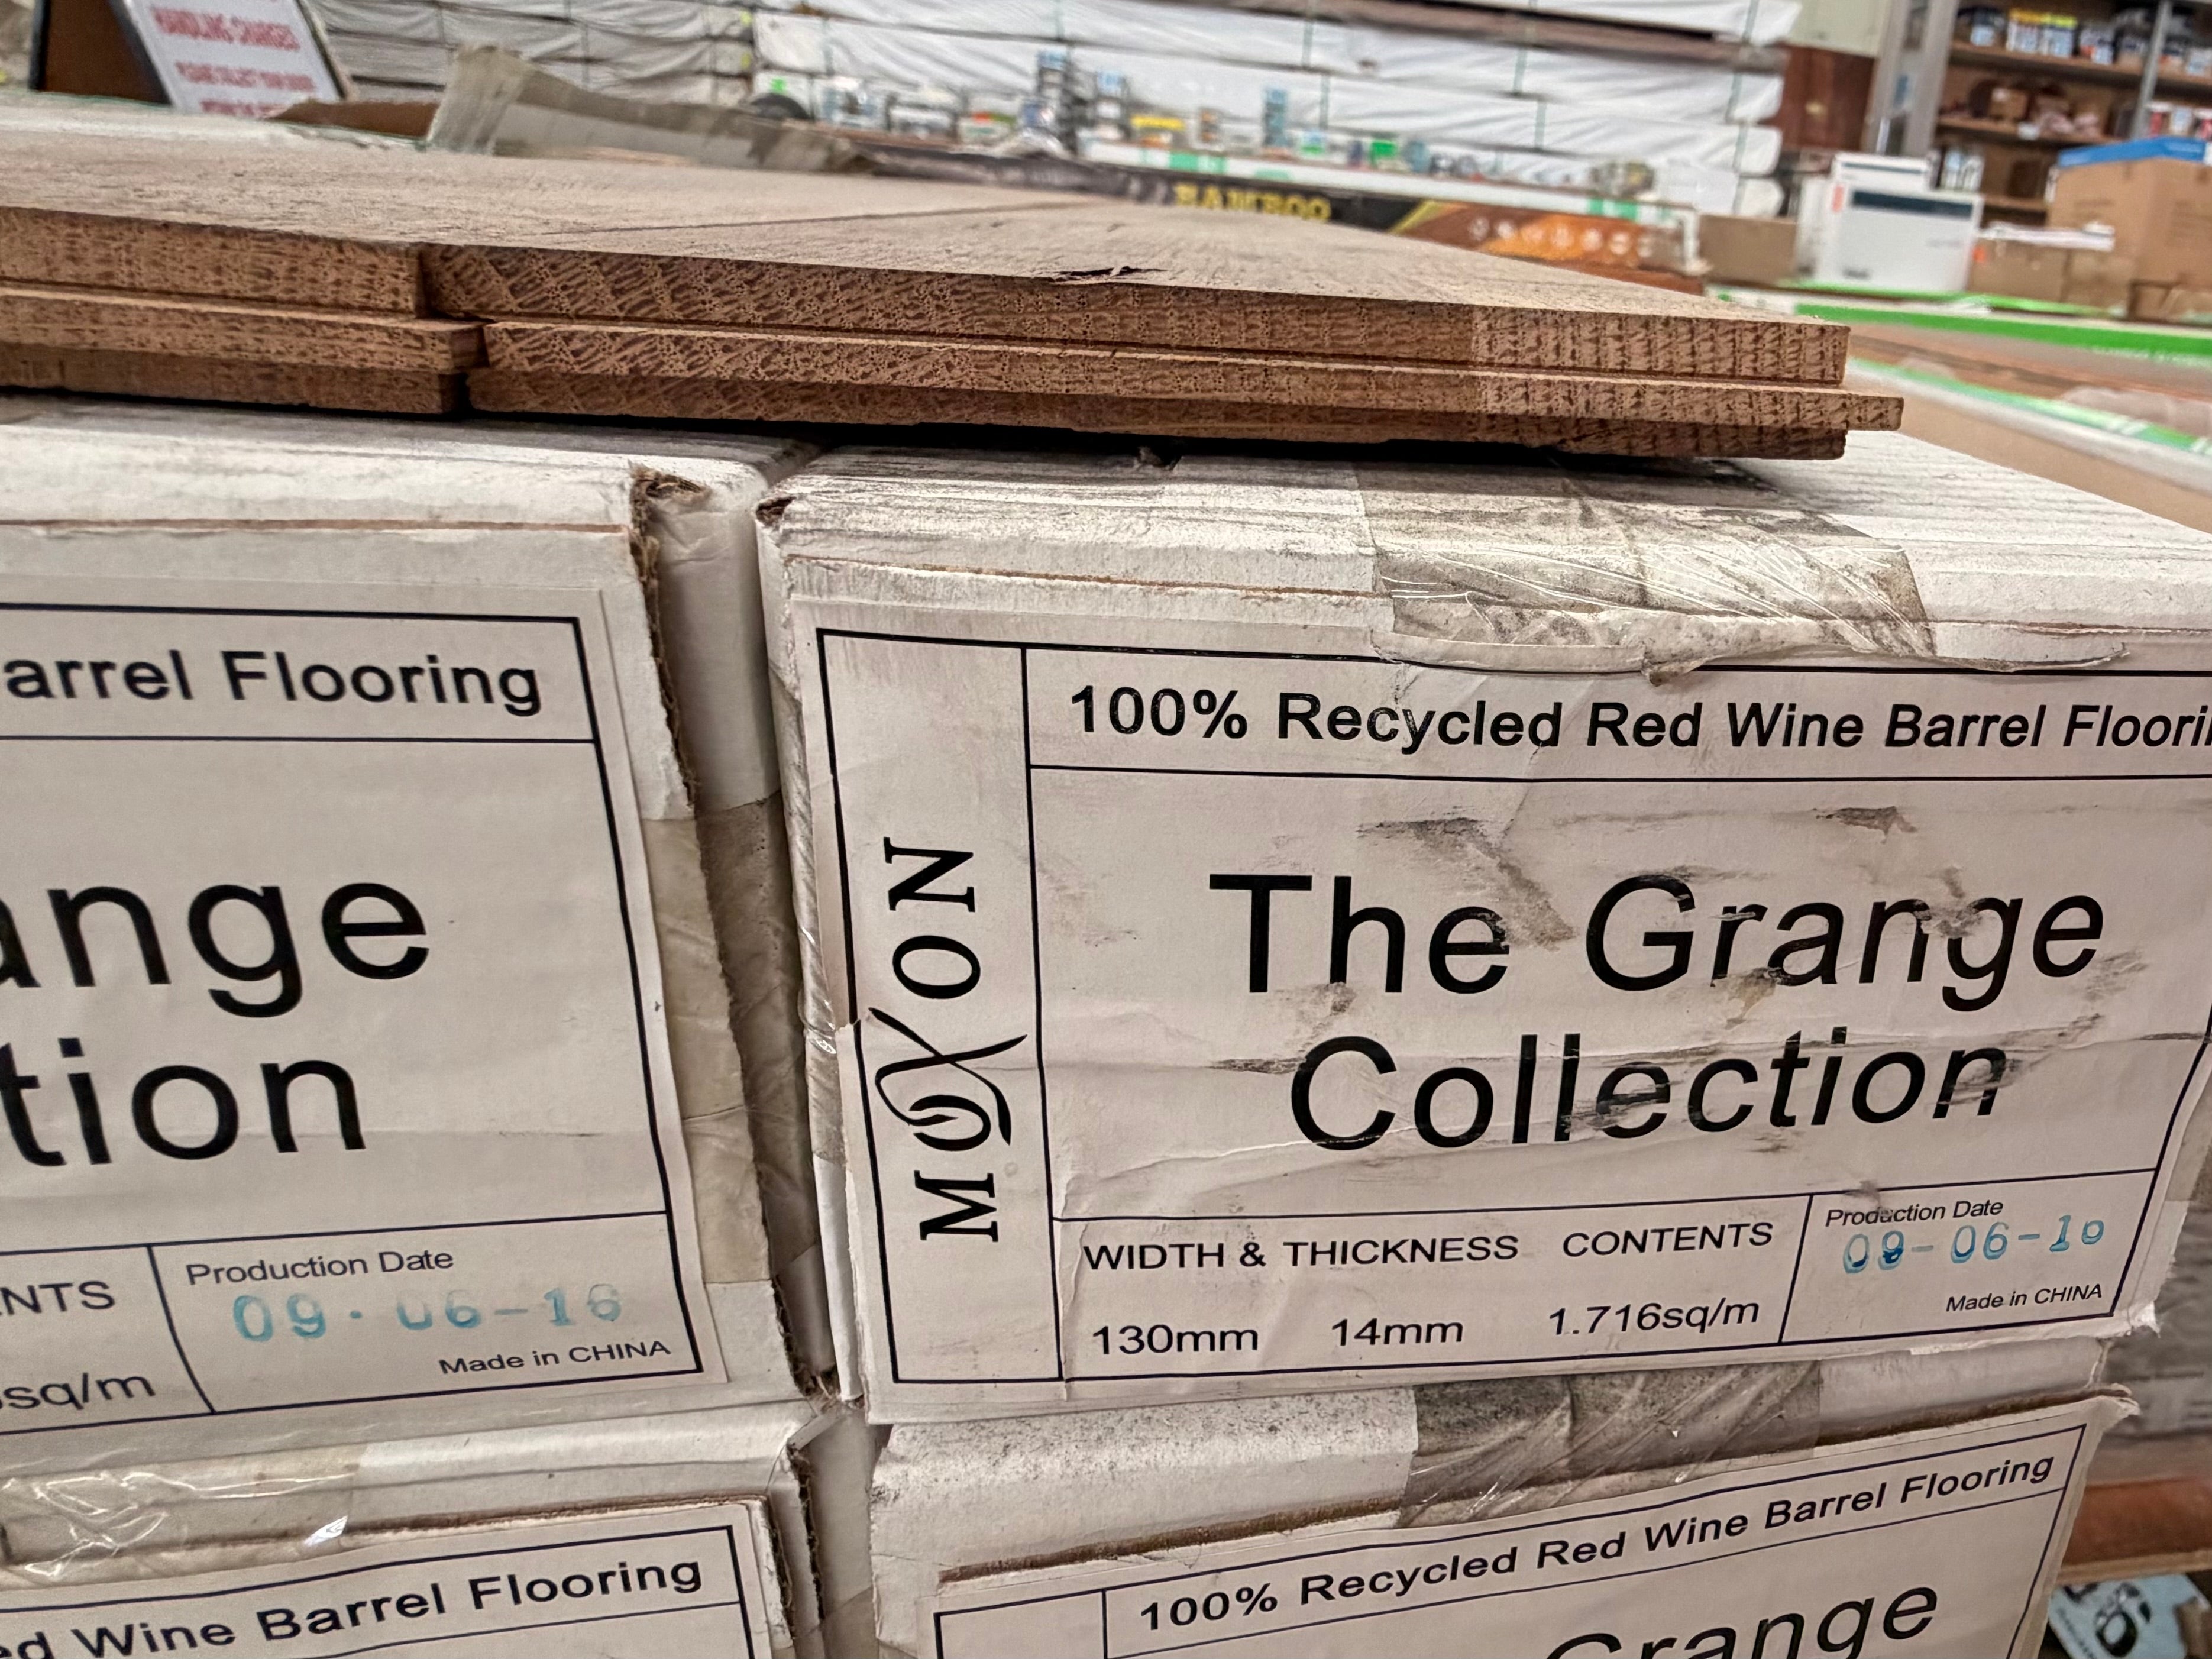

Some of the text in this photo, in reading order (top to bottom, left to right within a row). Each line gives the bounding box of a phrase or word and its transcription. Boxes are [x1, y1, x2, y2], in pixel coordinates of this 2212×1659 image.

[4, 649, 542, 718] arrel Flooring
[1072, 685, 2212, 756] 100% Recycled Red Wine Barrel Floori
[1209, 874, 2104, 1013] The Grange
[868, 836, 1029, 1243] MOXON
[0, 1037, 367, 1168] tion
[1289, 1026, 2008, 1152] Collection
[1825, 1199, 2005, 1229] Production Date
[1083, 1235, 1519, 1271] WIDTH & THICKNESS
[1563, 1222, 1774, 1259] CONTENTS
[186, 1250, 455, 1286] Production Date
[0, 1280, 117, 1317] NTS
[1550, 1297, 1760, 1336] 1.716sq/m
[1946, 1283, 2103, 1313] Made in CHINA
[1093, 1324, 1259, 1356] 130mm
[1332, 1318, 1464, 1347] 14mm
[439, 1341, 672, 1375] Made in CHINA
[0, 1373, 157, 1412] sq/m
[1140, 1455, 2056, 1631] 100% Recycled Red Wine Barrel Flooring
[71, 1622, 237, 1659] Wine
[256, 1582, 447, 1642] Barrel
[468, 1560, 704, 1611] Flooring
